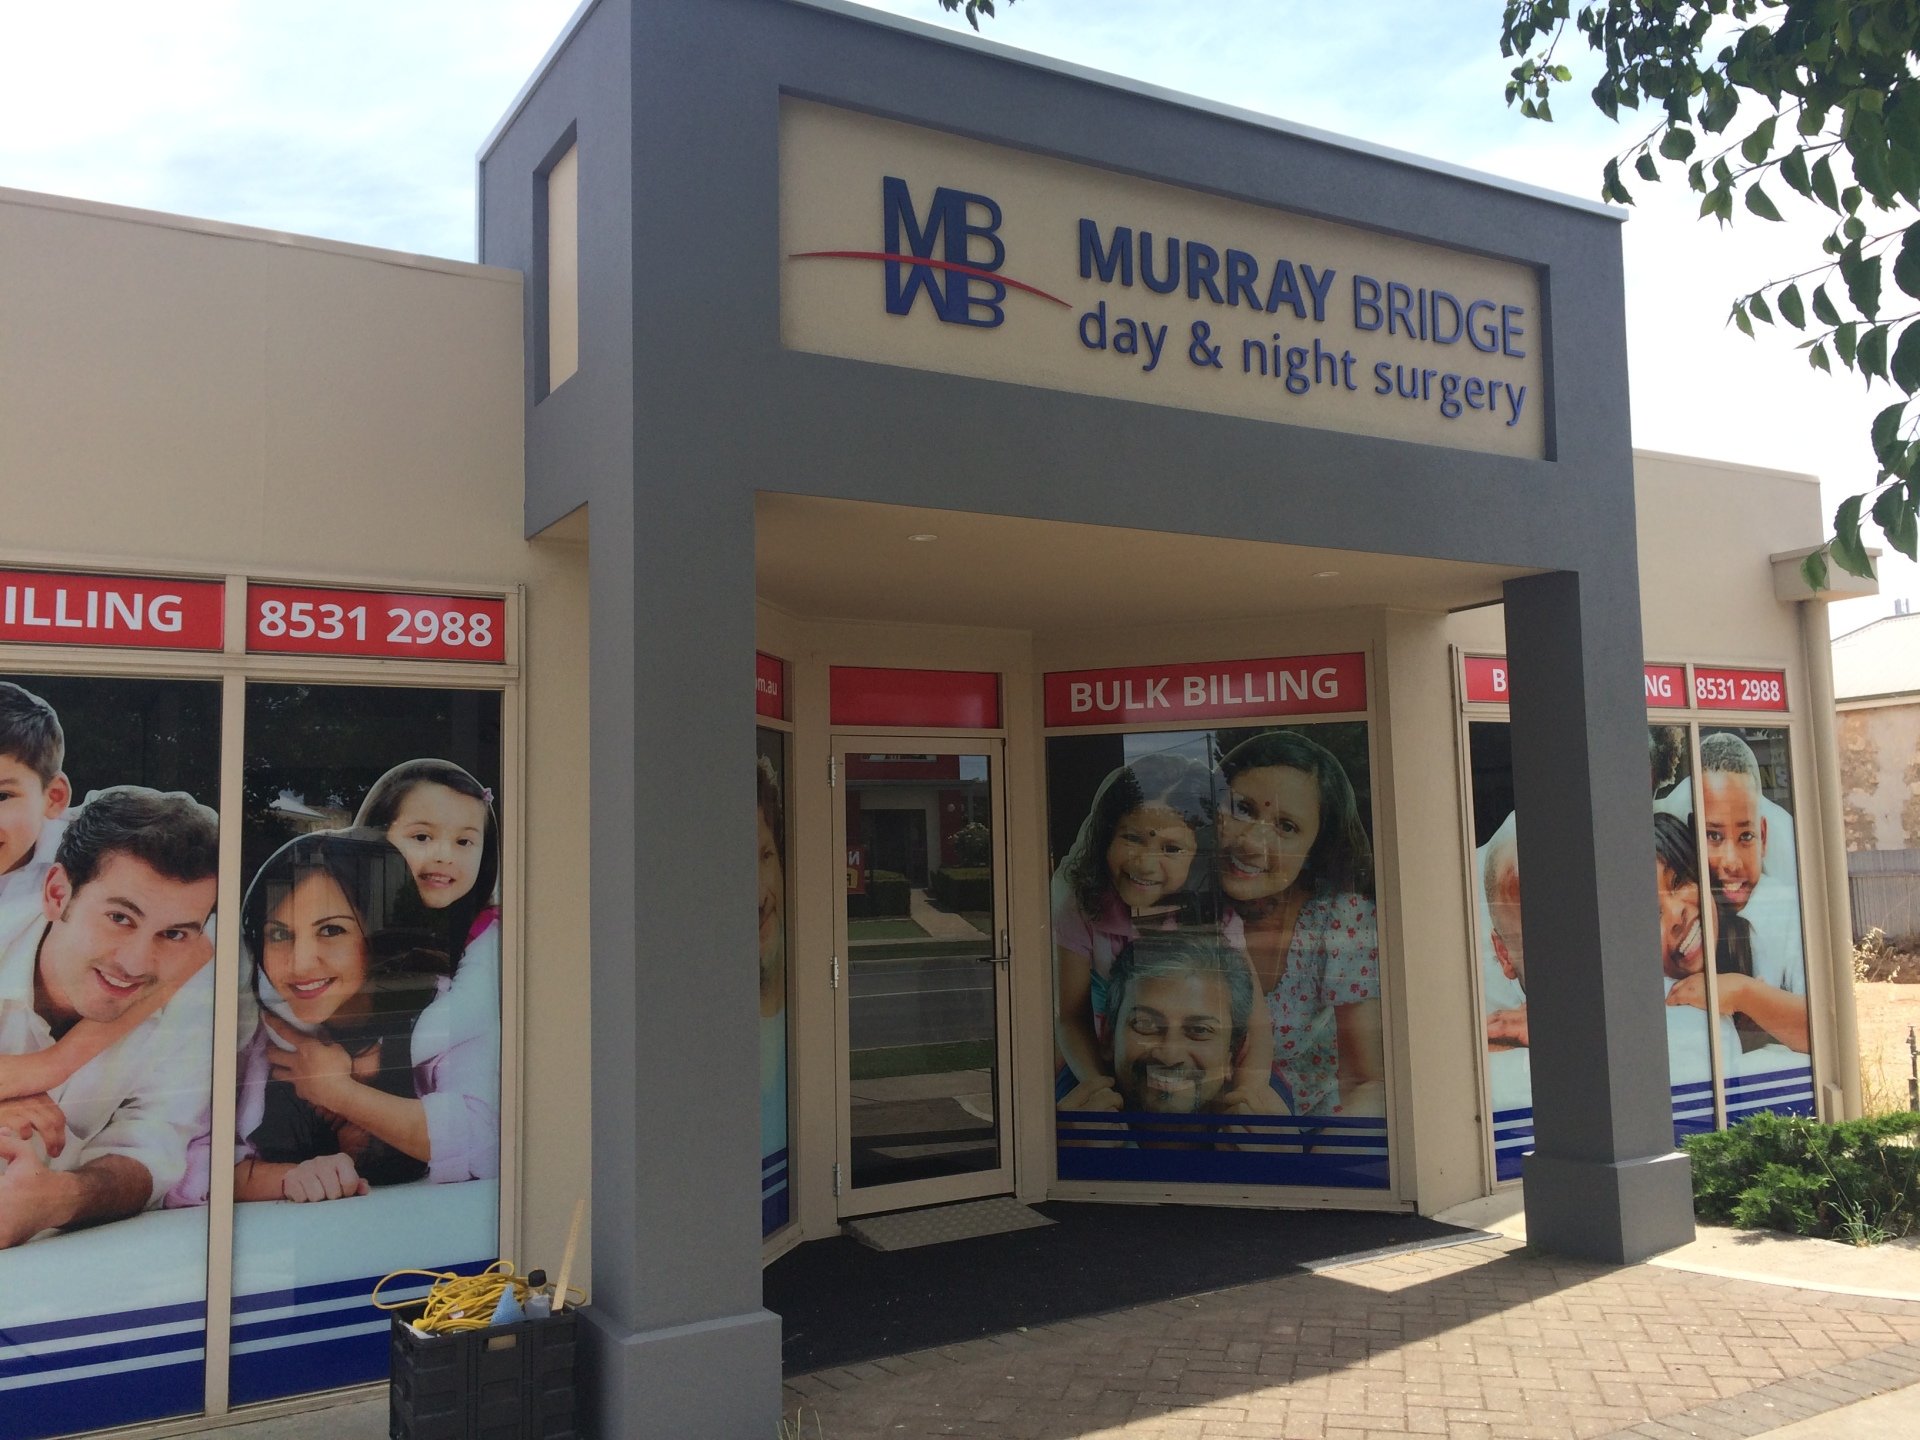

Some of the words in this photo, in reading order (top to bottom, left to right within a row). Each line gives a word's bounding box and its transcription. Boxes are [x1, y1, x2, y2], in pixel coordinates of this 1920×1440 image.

[1079, 218, 1336, 322] MURRAY
[1352, 275, 1526, 358] BRIDGE
[1079, 301, 1167, 371] day
[1188, 320, 1223, 369] &
[1243, 334, 1357, 395] night
[1373, 362, 1527, 427] surgery
[4, 586, 183, 632] ILLING
[259, 600, 366, 641] 8531
[386, 608, 493, 648] 2988
[755, 677, 778, 696] m.au
[1070, 678, 1171, 713] BULK
[1183, 667, 1339, 706] BILLING
[1696, 677, 1735, 701] 8531
[1741, 681, 1781, 702] 2988
